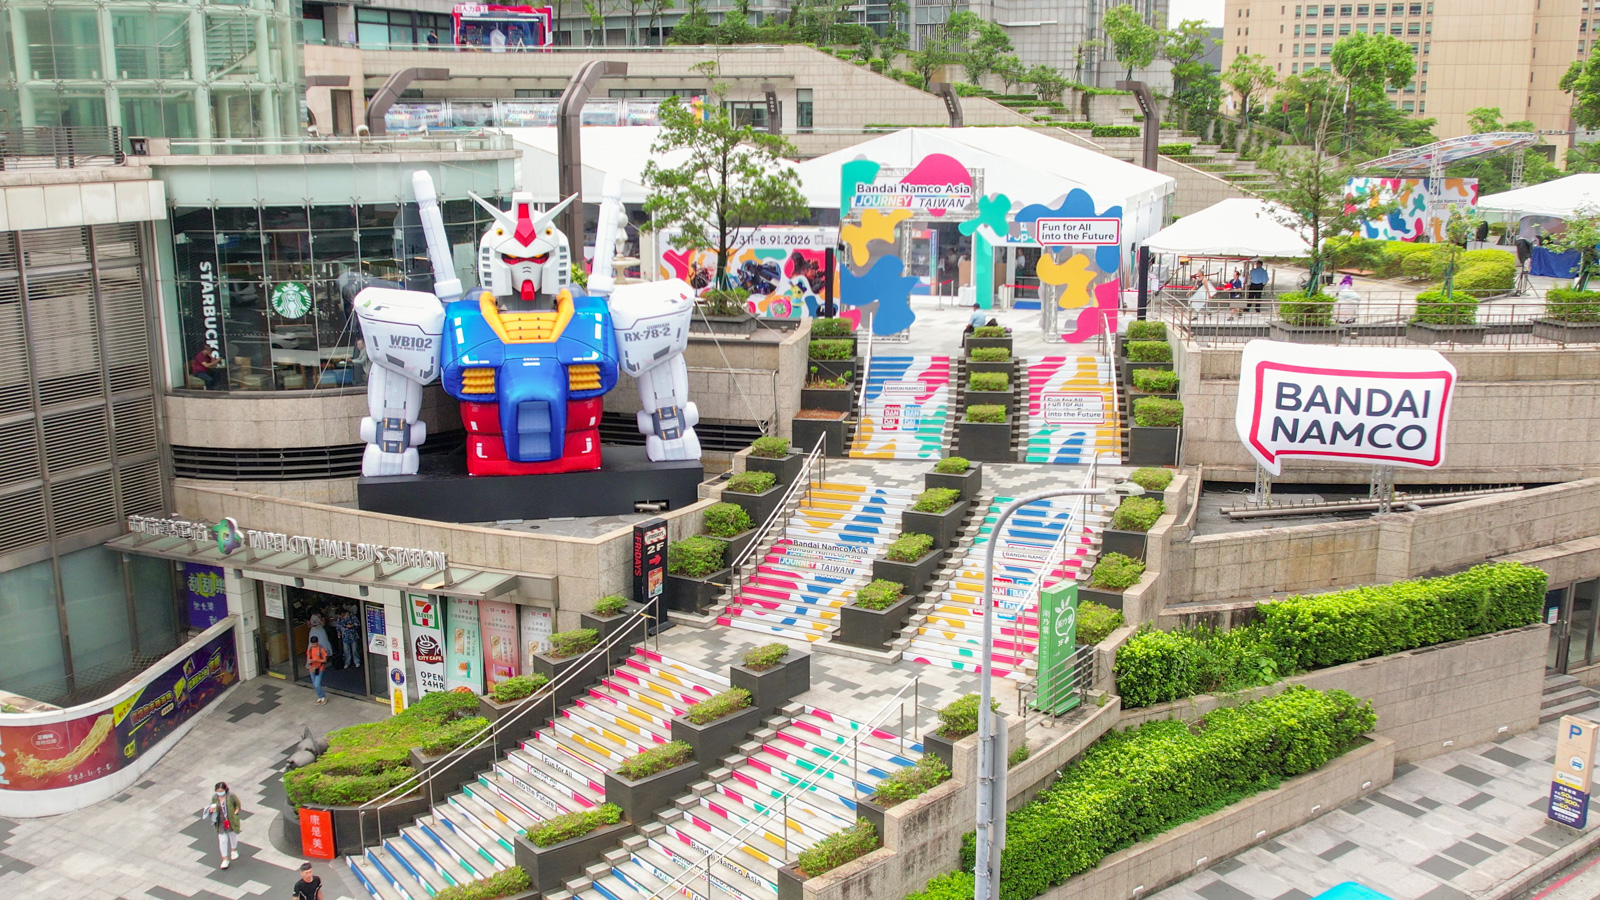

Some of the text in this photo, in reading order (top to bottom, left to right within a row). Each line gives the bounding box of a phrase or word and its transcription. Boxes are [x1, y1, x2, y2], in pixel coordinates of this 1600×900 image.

[857, 184, 970, 194] Bandai Namco Asia
[857, 195, 911, 207] JOURNEY
[920, 198, 965, 208] TAIWAN
[1042, 222, 1092, 232] Fun for All
[1042, 232, 1115, 241] into the Future
[390, 334, 433, 349] WB102
[624, 327, 671, 342] RX-78-2
[1275, 381, 1431, 419] BANDAI
[1271, 415, 1428, 451] NAMCO
[128, 514, 208, 542] 市府轉運站
[247, 530, 447, 571] TAIPEI CITY HALL BUS STATION
[647, 541, 665, 555] 2F
[793, 539, 820, 549] Bandai
[821, 543, 849, 553] Namco
[850, 546, 868, 555] Asia
[634, 536, 642, 576] FRIDAYS
[781, 557, 815, 568] JOURNEY
[821, 563, 852, 575] TAIWAN
[421, 671, 444, 682] OPEN
[1568, 724, 1582, 739] P
[515, 779, 555, 809] into the Future
[310, 814, 323, 849] 康是美
[745, 872, 762, 887] Asia
